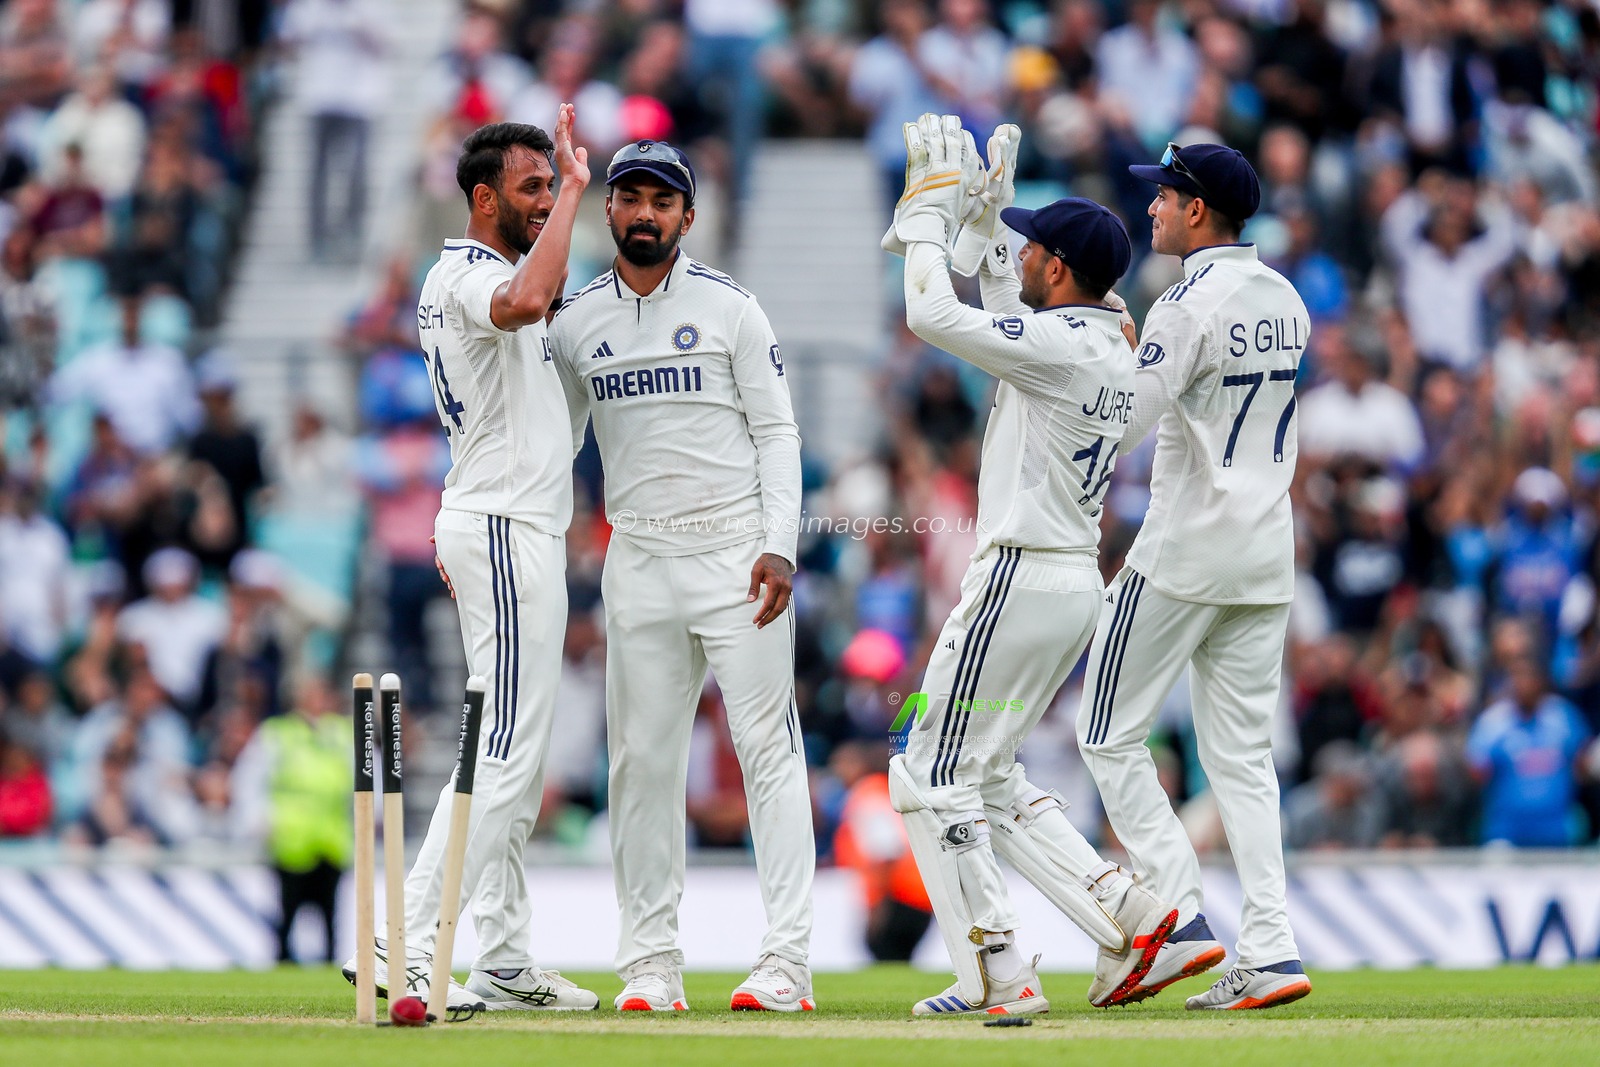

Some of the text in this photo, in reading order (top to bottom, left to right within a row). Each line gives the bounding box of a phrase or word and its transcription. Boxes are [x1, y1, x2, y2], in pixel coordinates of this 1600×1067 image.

[1229, 316, 1303, 358] S GILL
[423, 345, 465, 437] 4
[591, 366, 702, 401] DREAM11
[1222, 368, 1298, 467] 77
